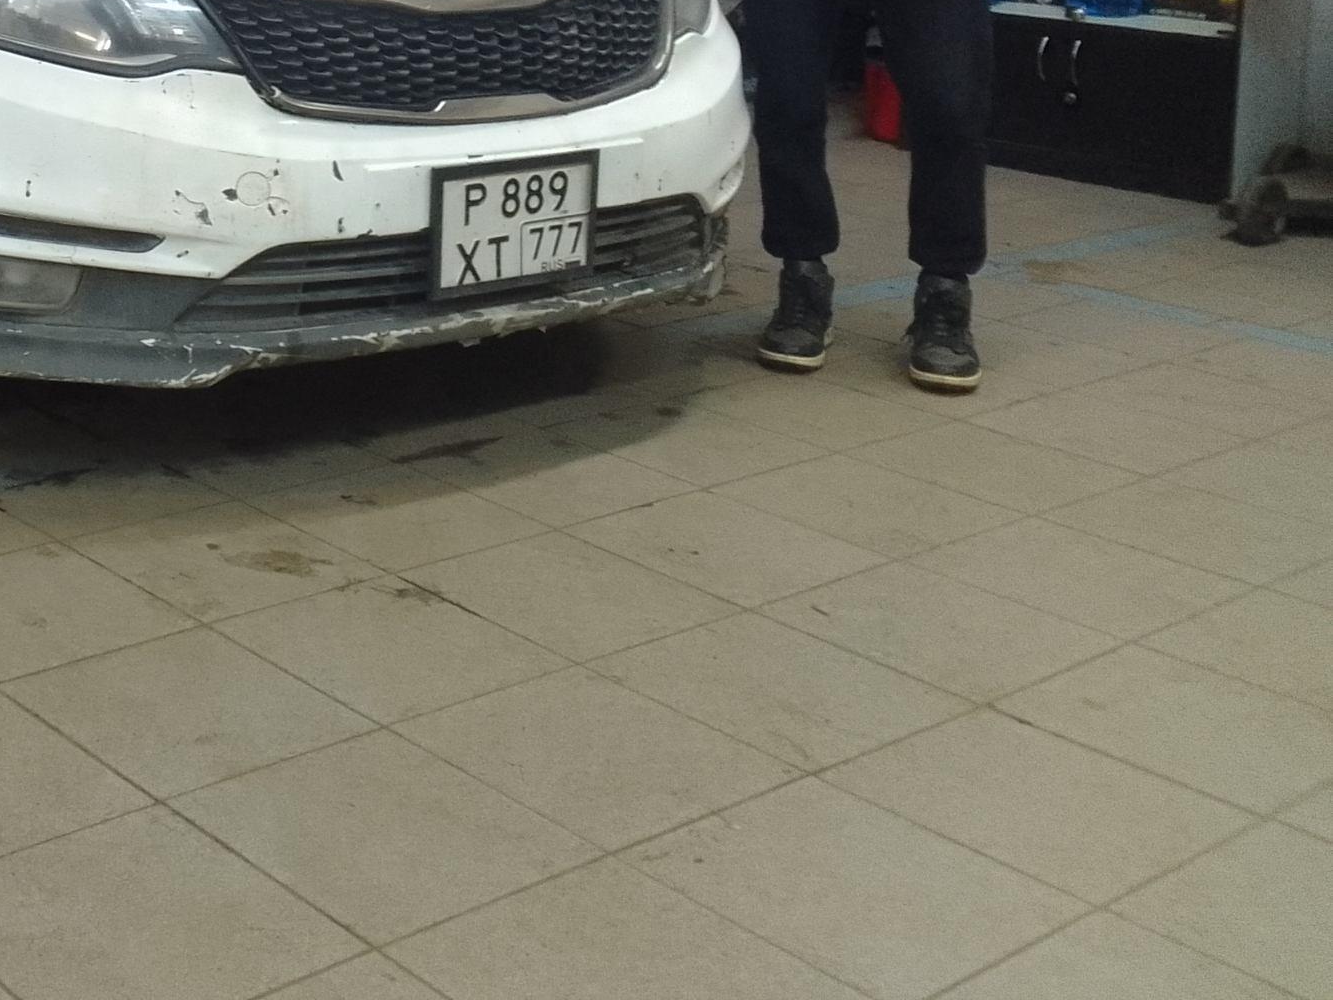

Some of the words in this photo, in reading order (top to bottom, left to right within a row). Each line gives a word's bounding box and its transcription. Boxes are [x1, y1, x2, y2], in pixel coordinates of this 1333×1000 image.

[464, 183, 487, 226] Р
[501, 170, 569, 218] 889
[456, 235, 510, 286] ХТ
[529, 221, 583, 260] 777
